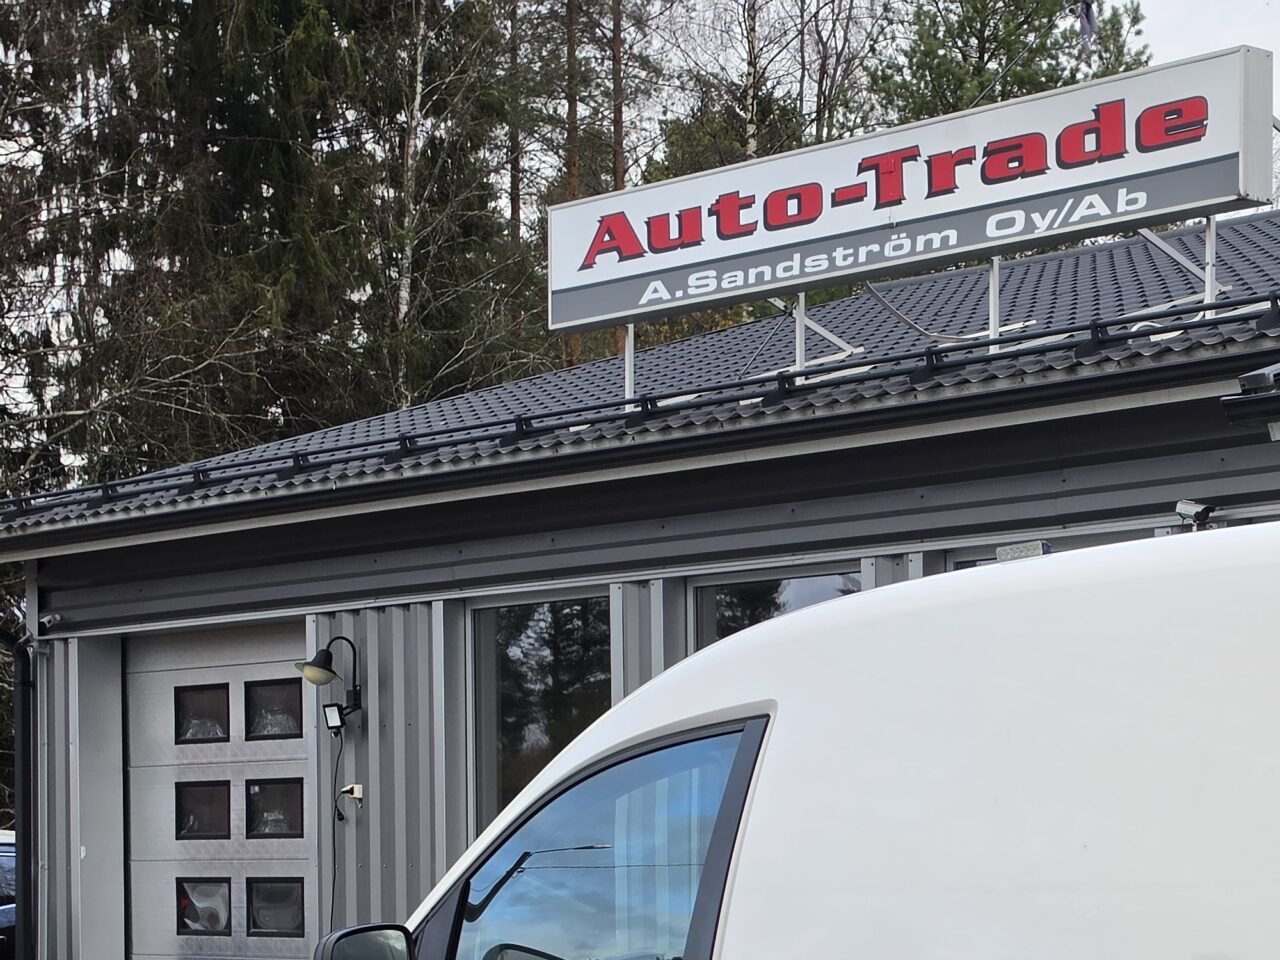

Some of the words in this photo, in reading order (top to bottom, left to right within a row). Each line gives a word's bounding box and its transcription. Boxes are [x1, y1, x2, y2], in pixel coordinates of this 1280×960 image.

[577, 96, 1208, 272] Auto-Trade
[638, 229, 957, 304] A.Sandström
[985, 188, 1147, 234] Oy/Ab
